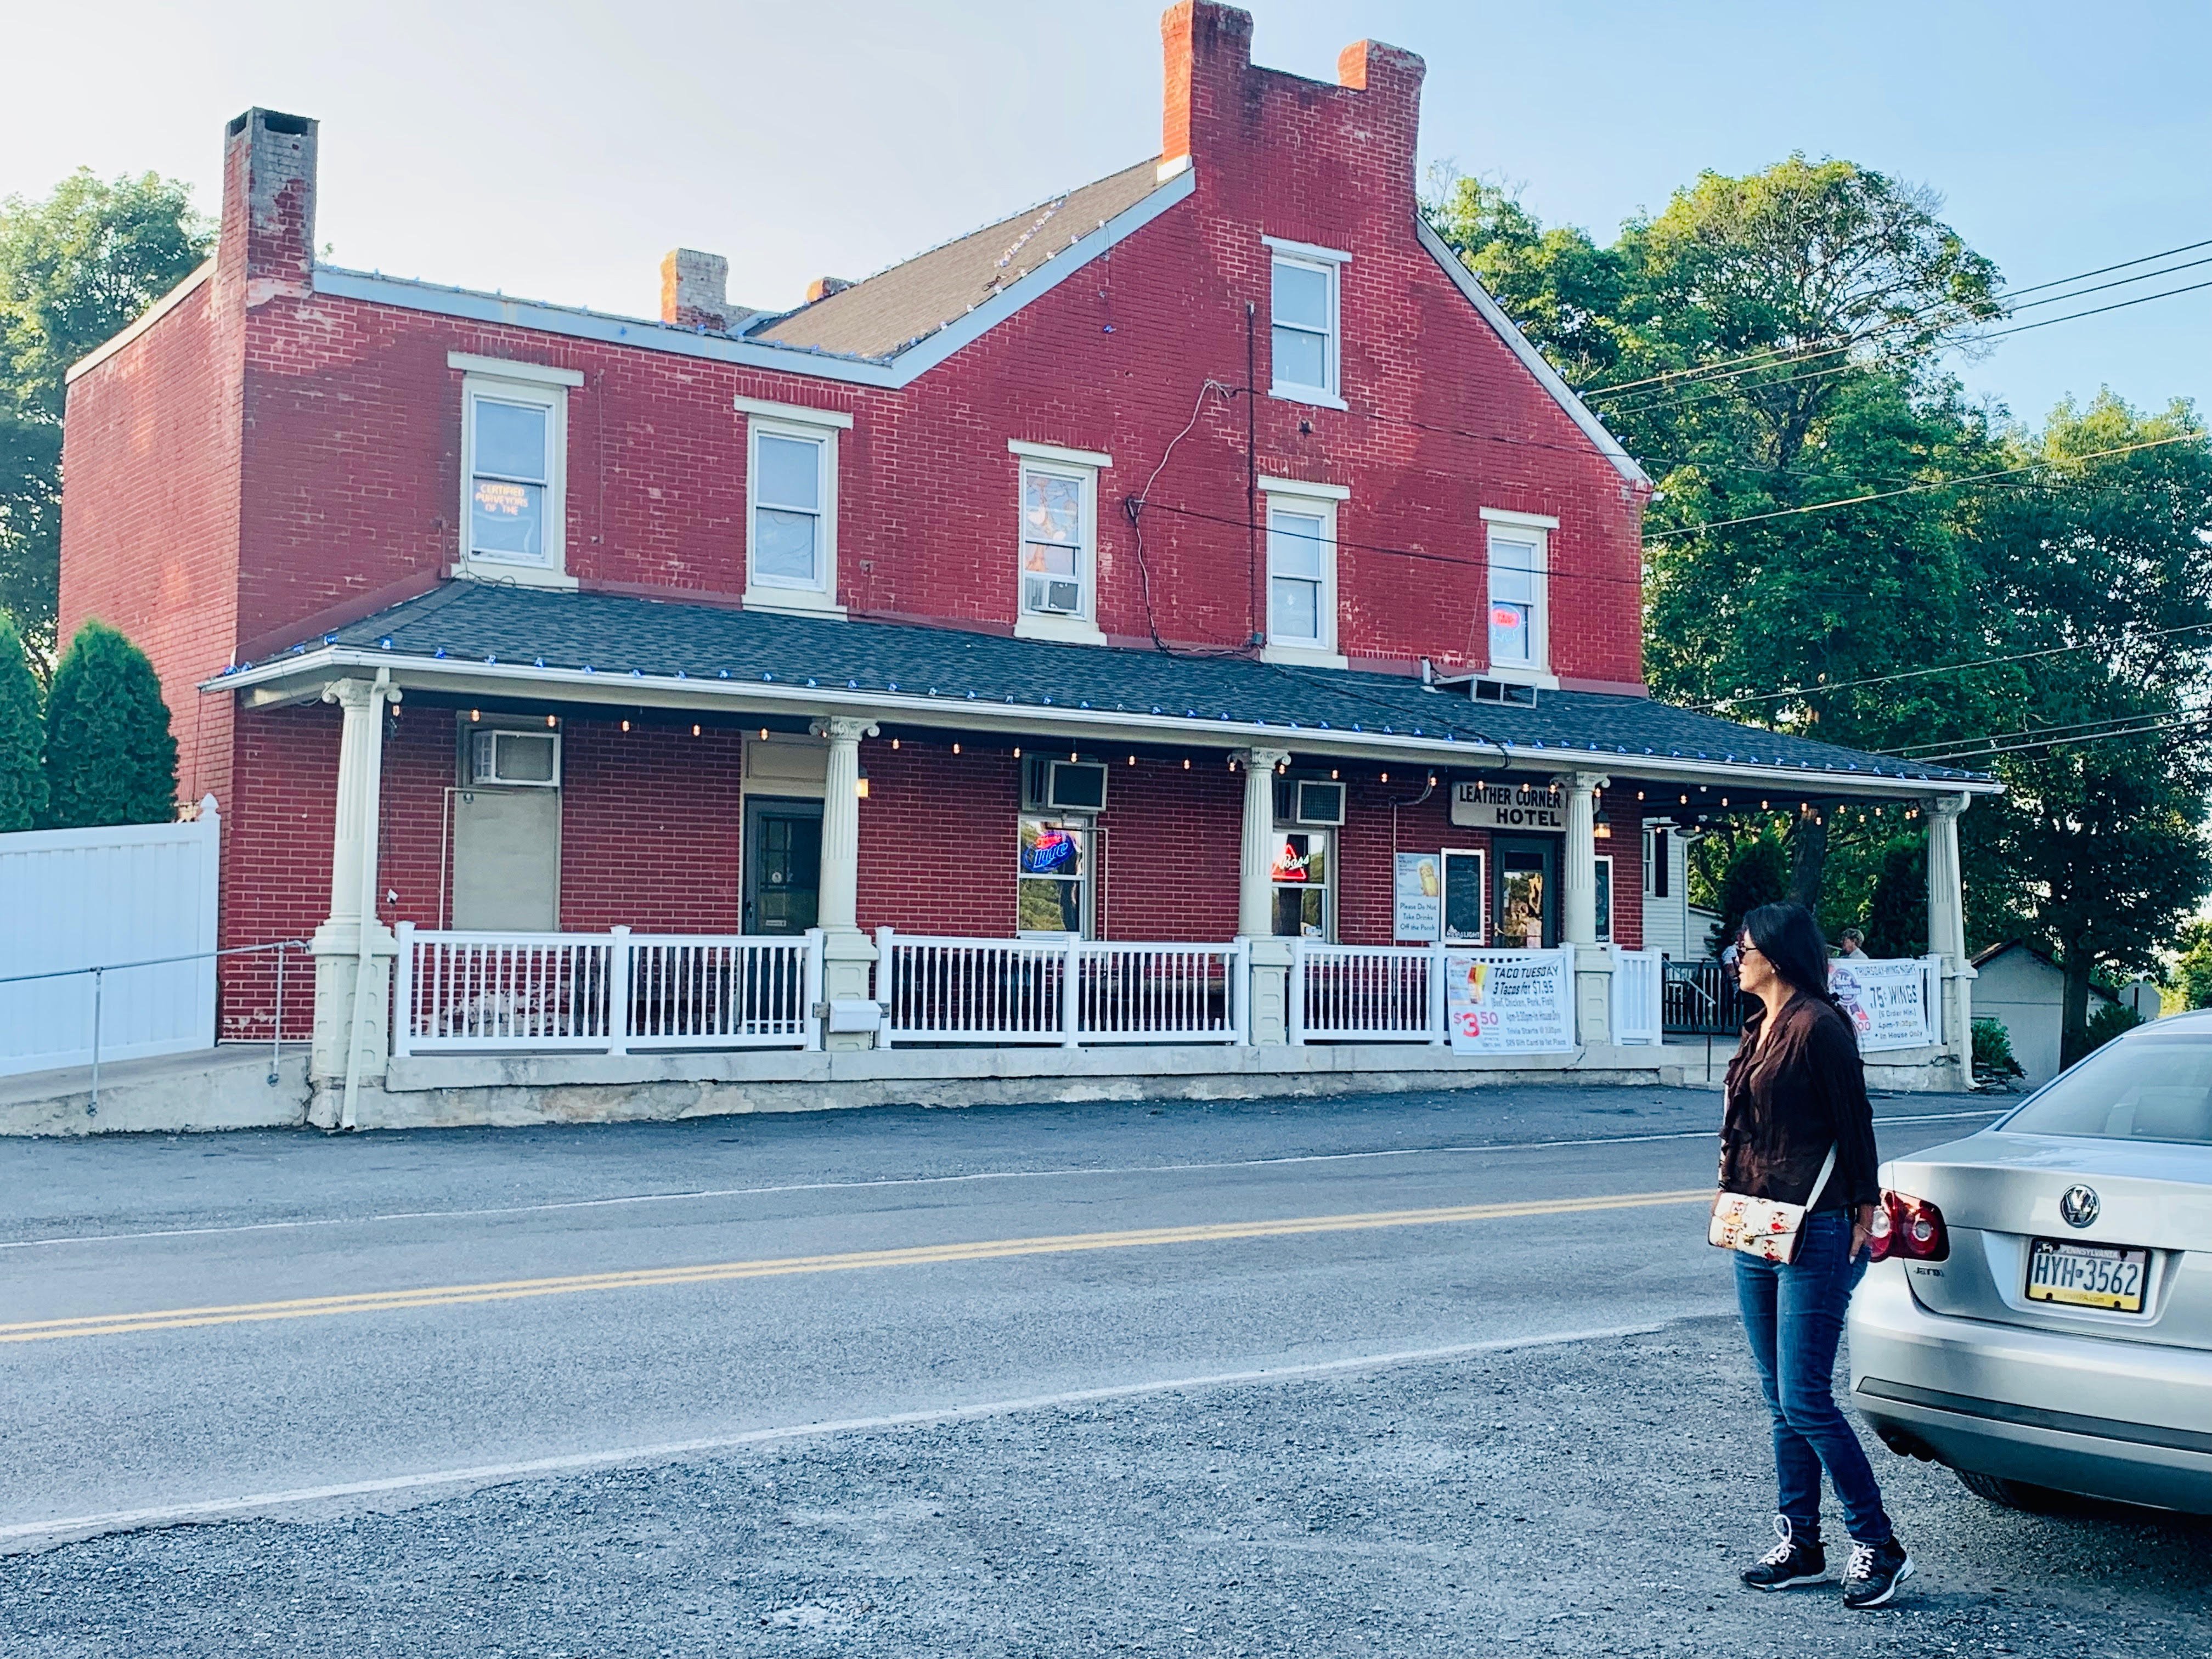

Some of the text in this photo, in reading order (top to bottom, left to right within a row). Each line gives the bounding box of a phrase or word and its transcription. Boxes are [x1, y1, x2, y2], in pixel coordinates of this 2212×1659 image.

[1459, 785, 1511, 805] LEATHER
[1516, 789, 1561, 809] CORNER
[1496, 808, 1561, 827] HOTEL
[1279, 853, 1310, 870] Bass
[1494, 965, 1559, 978] TACO TUESDAY
[1493, 981, 1499, 995] 3
[1500, 981, 1520, 995] Tacos
[1521, 981, 1531, 995] for
[1888, 984, 1917, 1005] WINGS
[2061, 1245, 2119, 1259] PENNSYLVANIA
